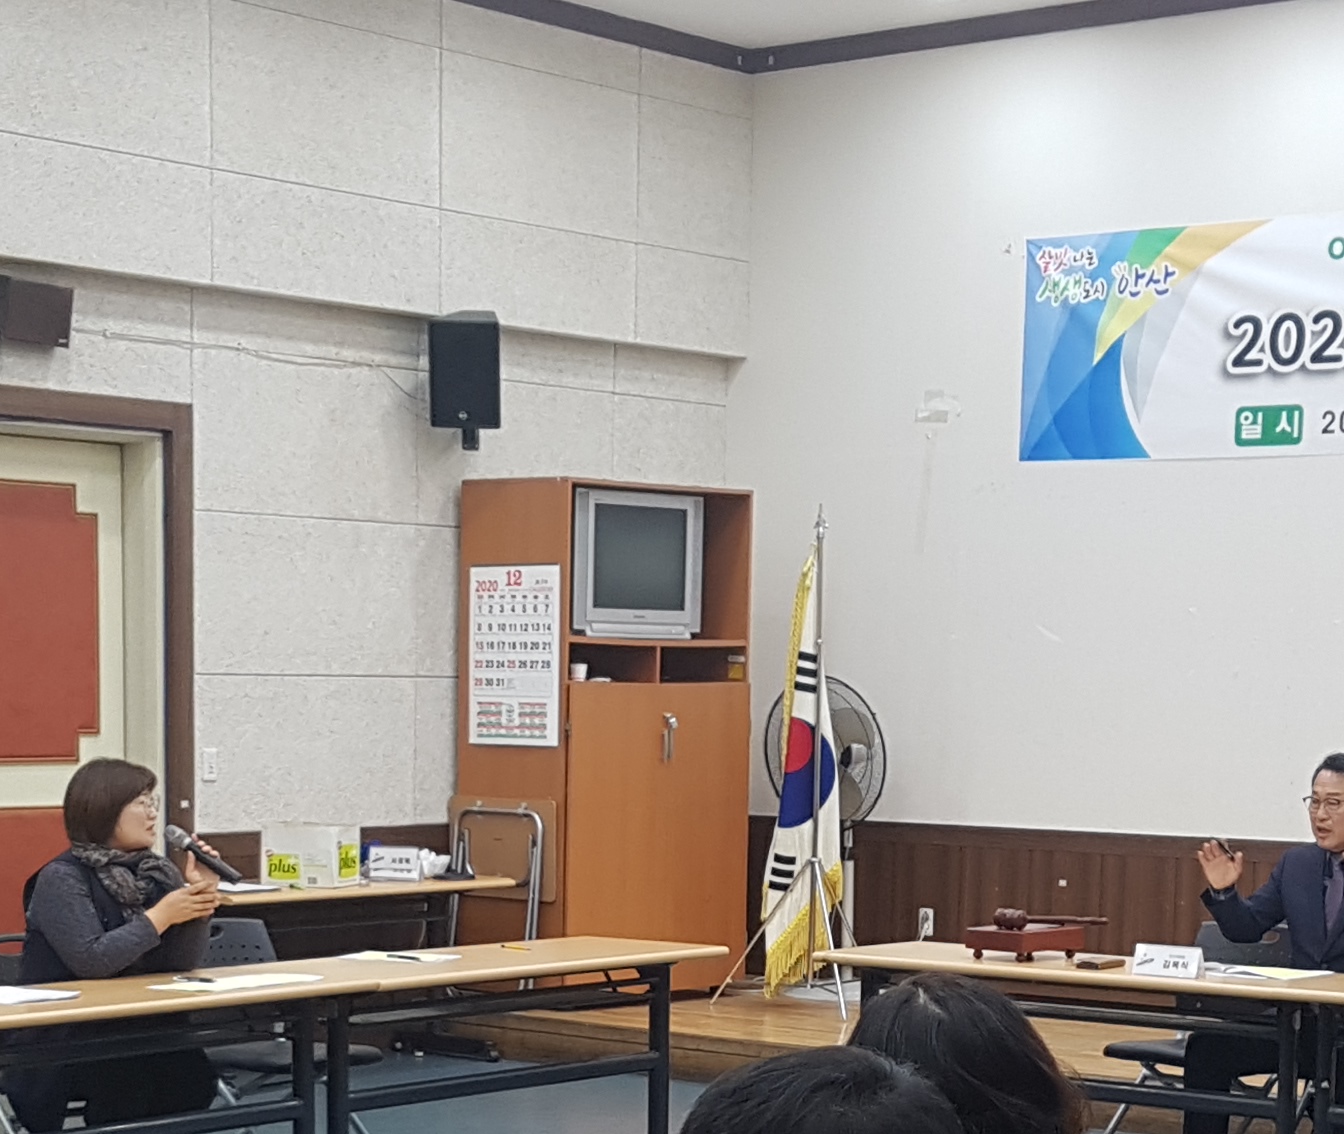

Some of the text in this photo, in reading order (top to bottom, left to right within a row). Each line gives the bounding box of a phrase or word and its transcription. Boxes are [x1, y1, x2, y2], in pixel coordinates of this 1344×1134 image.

[1115, 263, 1176, 298] 안산
[475, 579, 499, 593] 2020
[505, 569, 523, 587] 12
[267, 858, 297, 877] plus
